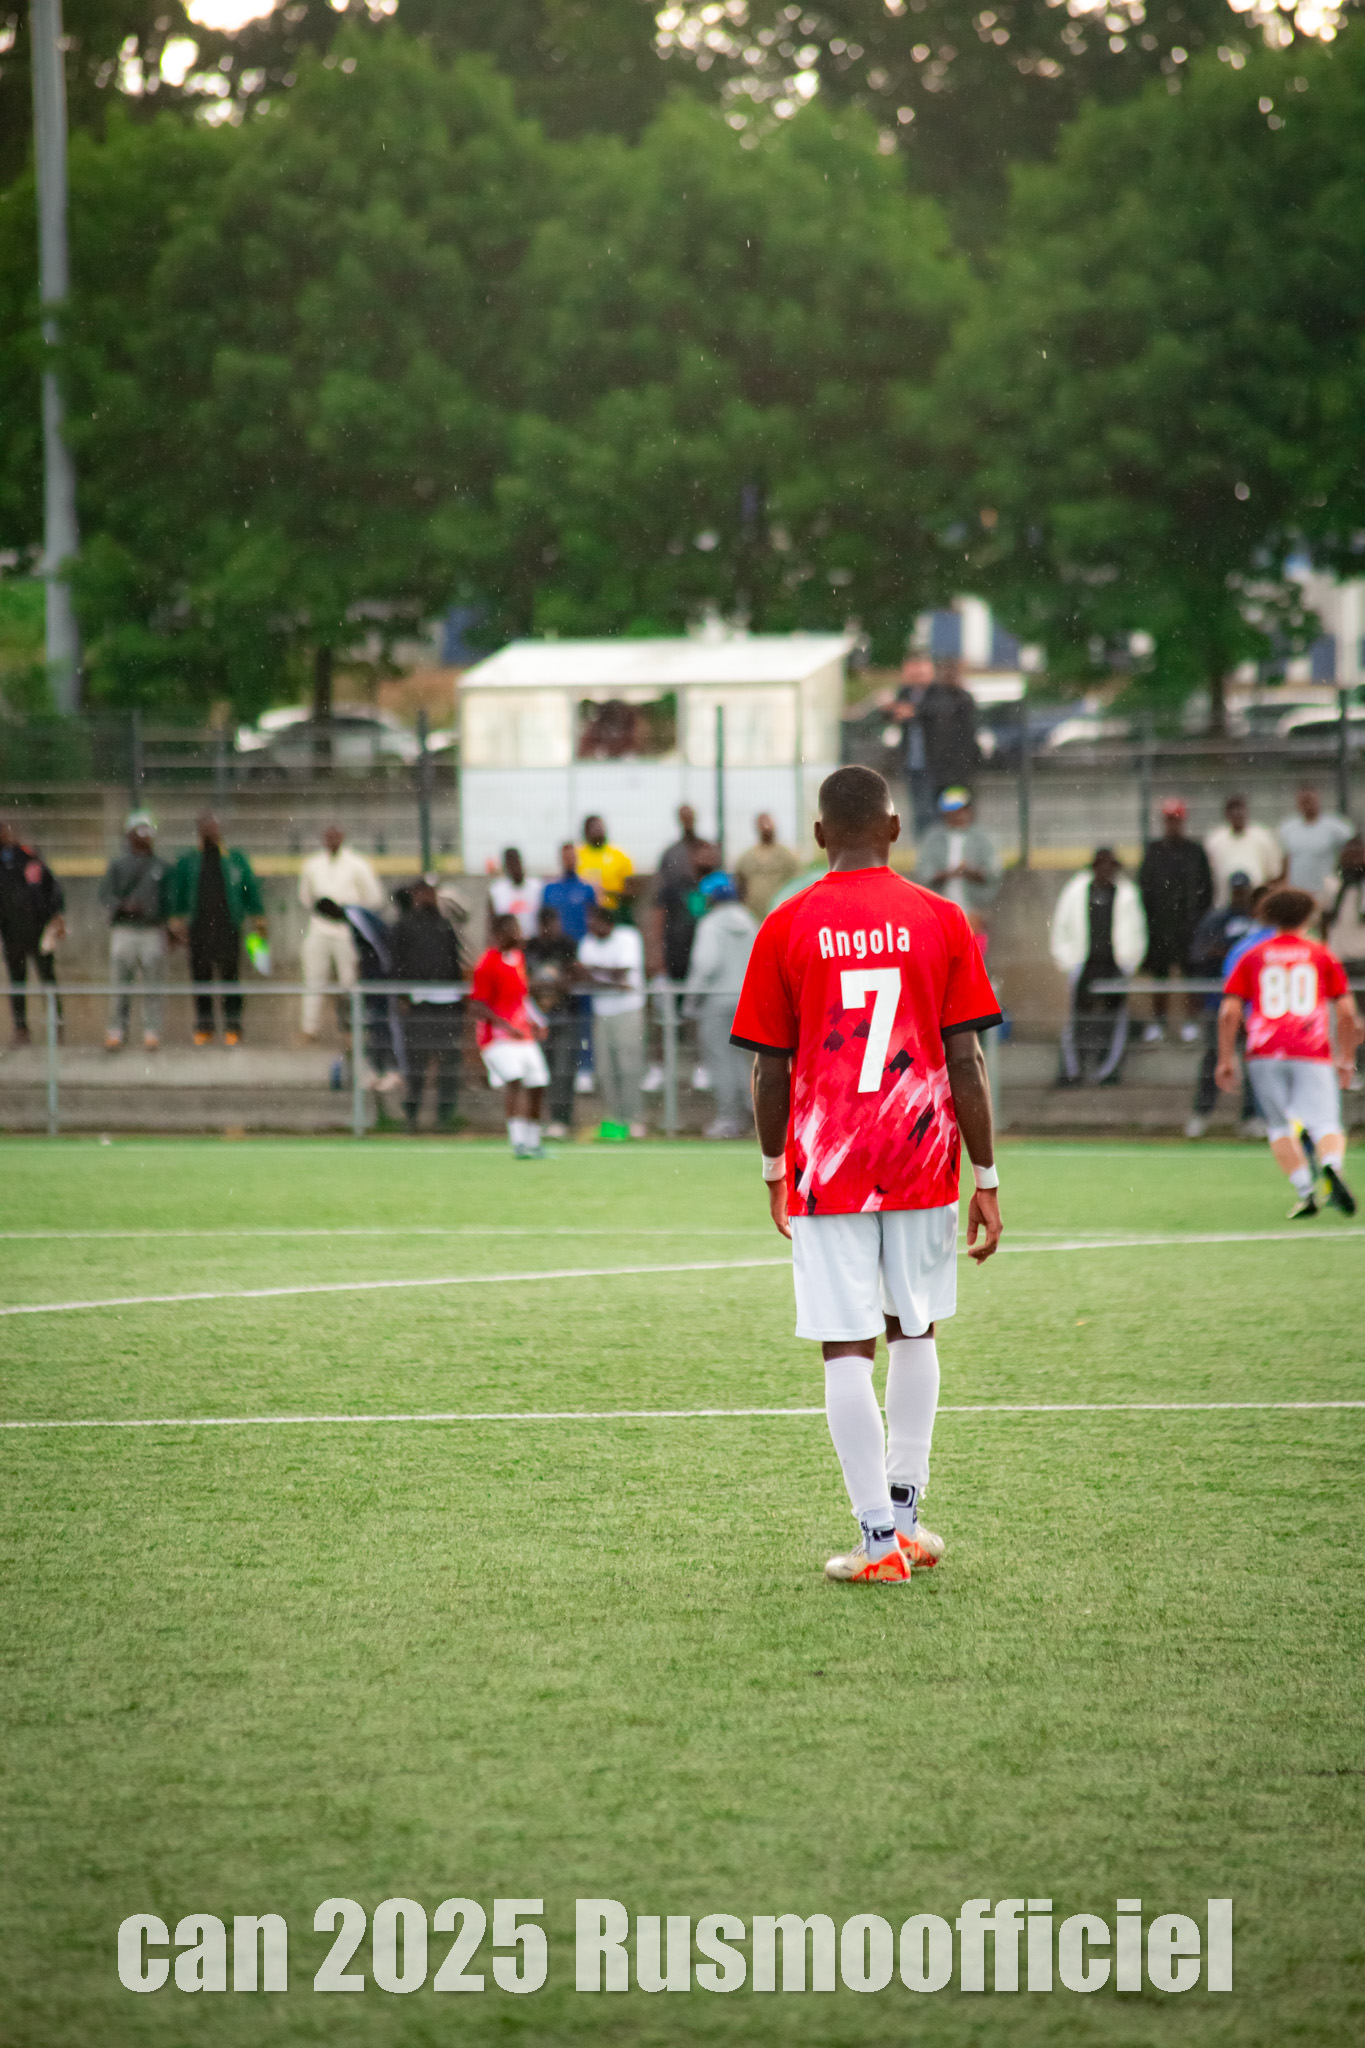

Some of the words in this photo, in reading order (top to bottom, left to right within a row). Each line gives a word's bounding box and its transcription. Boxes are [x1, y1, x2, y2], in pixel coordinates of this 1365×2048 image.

[818, 922, 910, 959] Angola
[1260, 963, 1318, 1019] 80
[840, 968, 901, 1093] 7
